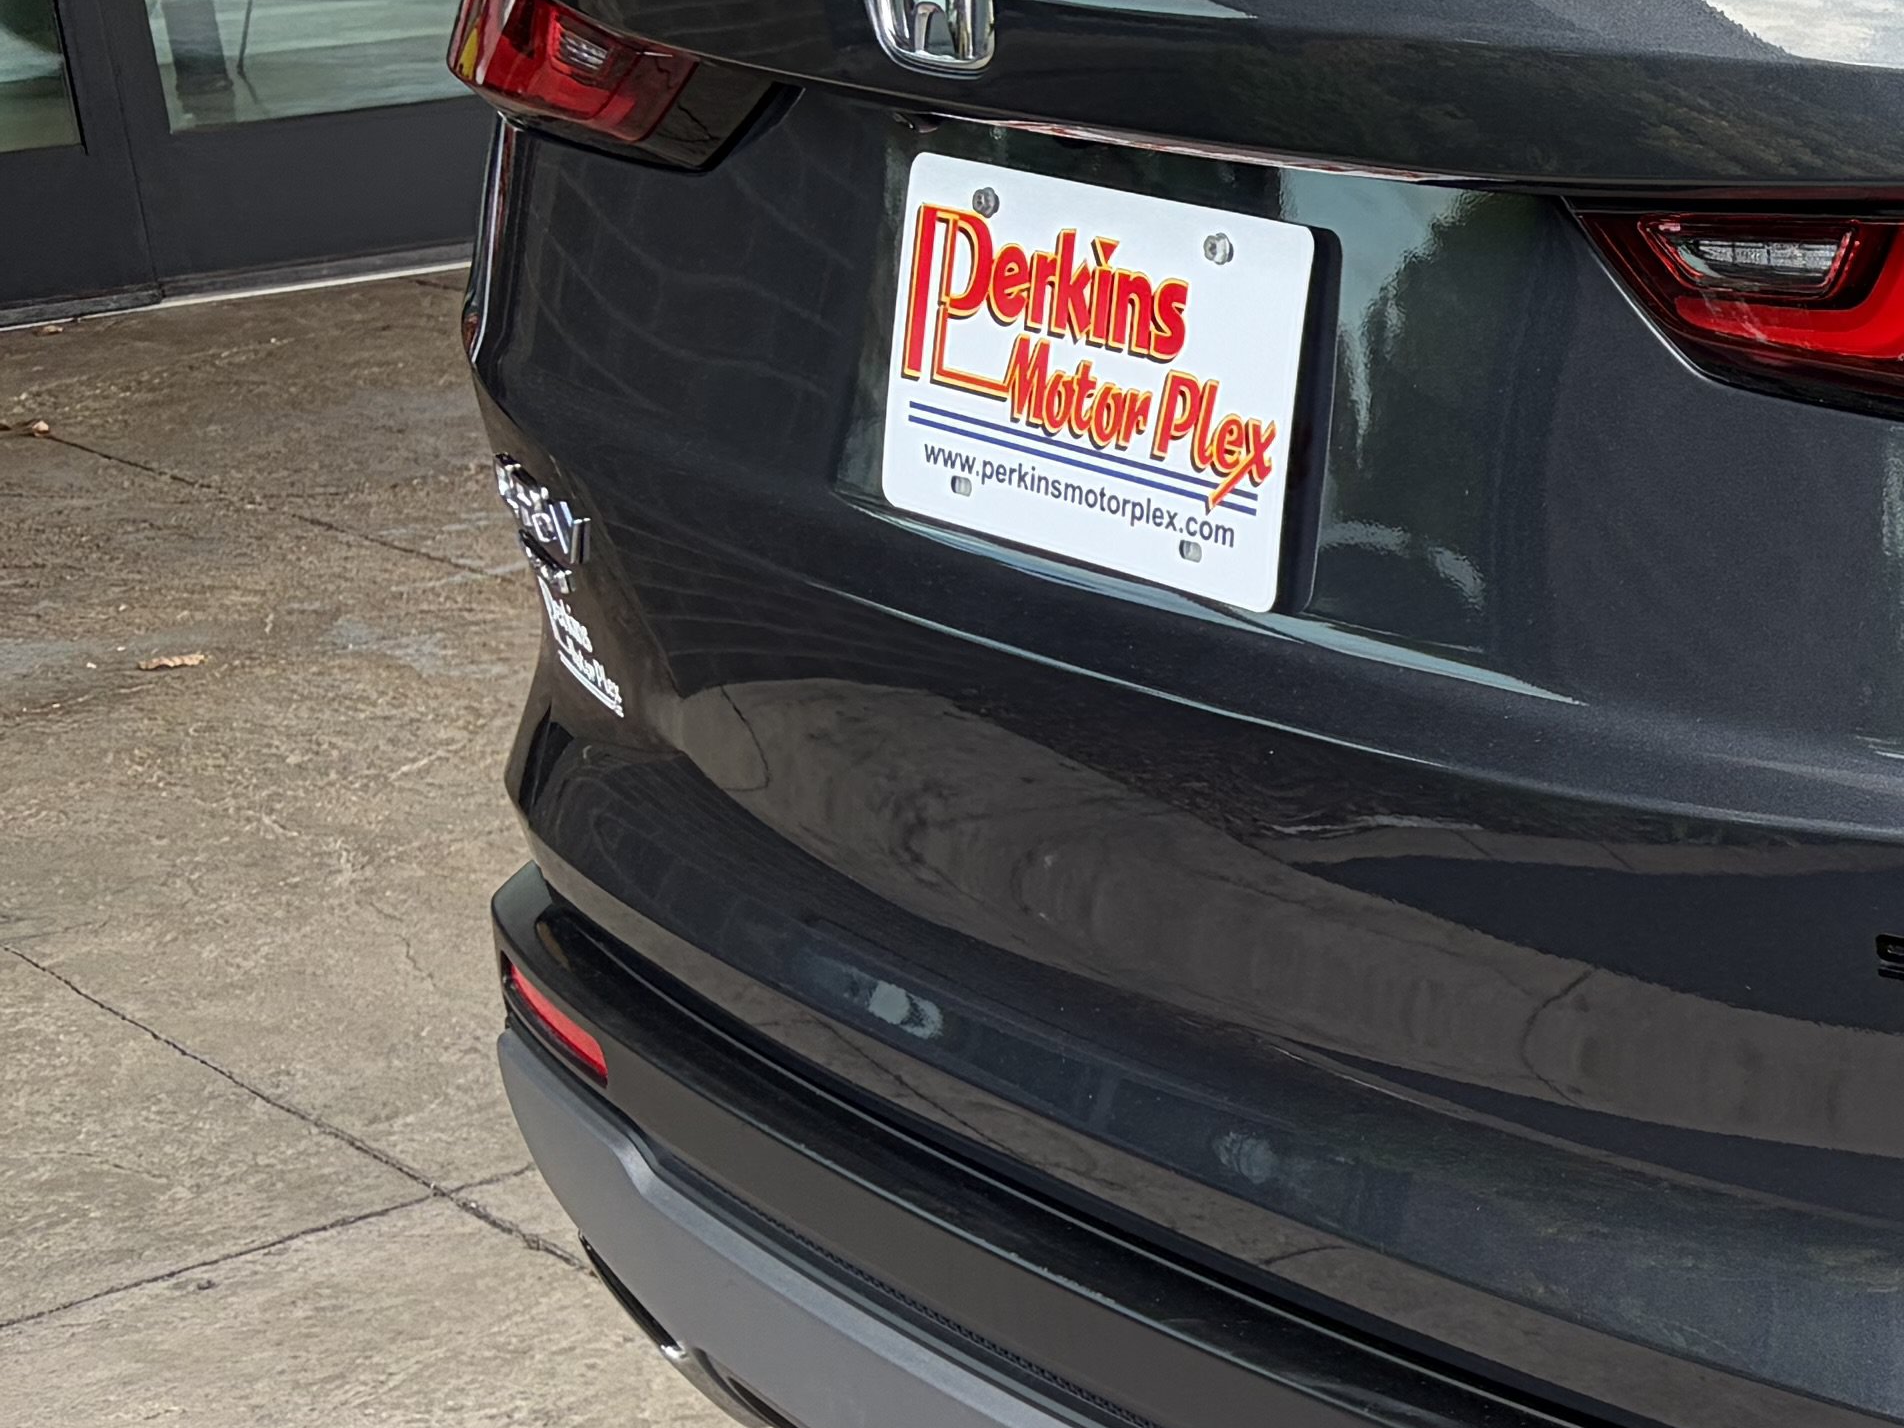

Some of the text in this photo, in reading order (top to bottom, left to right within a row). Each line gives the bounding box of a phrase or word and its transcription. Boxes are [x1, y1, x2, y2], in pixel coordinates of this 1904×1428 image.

[901, 202, 1189, 381] Perkins
[923, 442, 1236, 549] www.perkinsmotorplex.com
[1003, 333, 1277, 514] Motor Plex
